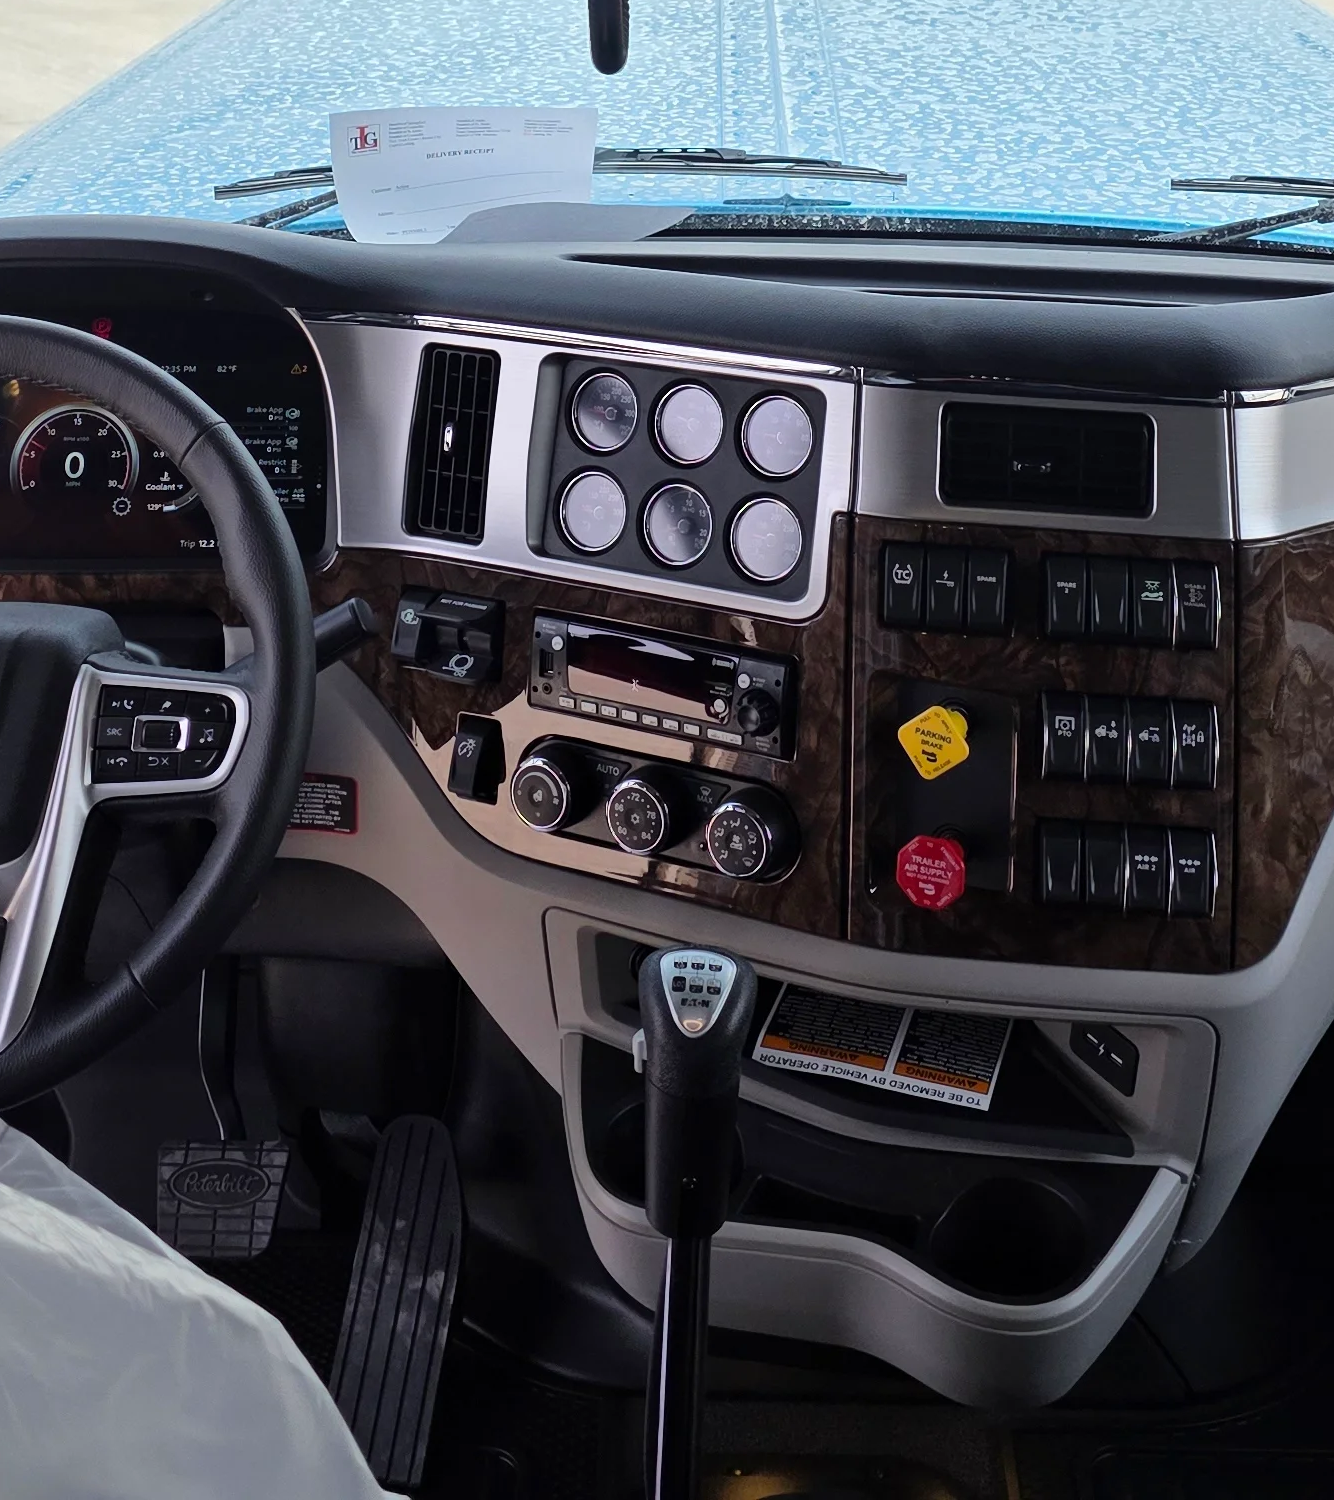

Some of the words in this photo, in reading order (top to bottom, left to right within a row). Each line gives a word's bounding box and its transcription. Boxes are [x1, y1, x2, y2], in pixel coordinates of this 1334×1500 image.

[349, 125, 378, 151] TLG
[426, 150, 462, 160] DELIVERY
[464, 147, 495, 156] RECEIPT
[183, 365, 197, 373] PM
[216, 365, 227, 373] 82
[302, 365, 308, 373] 2
[246, 406, 267, 414] Brake
[268, 406, 284, 415] App
[73, 418, 83, 426] 15
[47, 428, 56, 436] 10
[97, 428, 108, 436] 20
[267, 438, 282, 447] App
[30, 450, 36, 458] 5
[110, 450, 121, 458] 25
[64, 451, 85, 479] 0
[29, 480, 36, 488] 0
[145, 483, 176, 491] Coolant
[698, 509, 707, 518] 15
[699, 528, 708, 537] 20
[180, 540, 196, 549] Trip
[198, 540, 215, 548] 12.2
[976, 575, 997, 583] SPARE
[1056, 581, 1077, 589] SPARE
[106, 727, 123, 737] SRC
[914, 727, 953, 745] PARKING
[1057, 729, 1073, 738] PTO
[920, 739, 944, 751] BRAKE
[596, 762, 621, 777] AUTO
[630, 792, 641, 802] 72
[696, 794, 714, 805] MAX
[640, 831, 652, 841] 84
[911, 854, 947, 870] TRAILER
[1136, 863, 1150, 871] AIR
[904, 863, 919, 873] AIR
[919, 866, 953, 880] SUPPLY
[680, 997, 711, 1008] EATON
[788, 1041, 848, 1061] WARNING
[759, 1052, 820, 1072] OPERATOR
[820, 1063, 869, 1081] VEHICLE
[905, 1066, 964, 1086] WARNING
[870, 1075, 887, 1086] BY
[889, 1078, 946, 1099] REMOVED
[947, 1092, 964, 1103] BE
[965, 1096, 982, 1106] TO
[182, 1169, 260, 1196] Peterbilt
